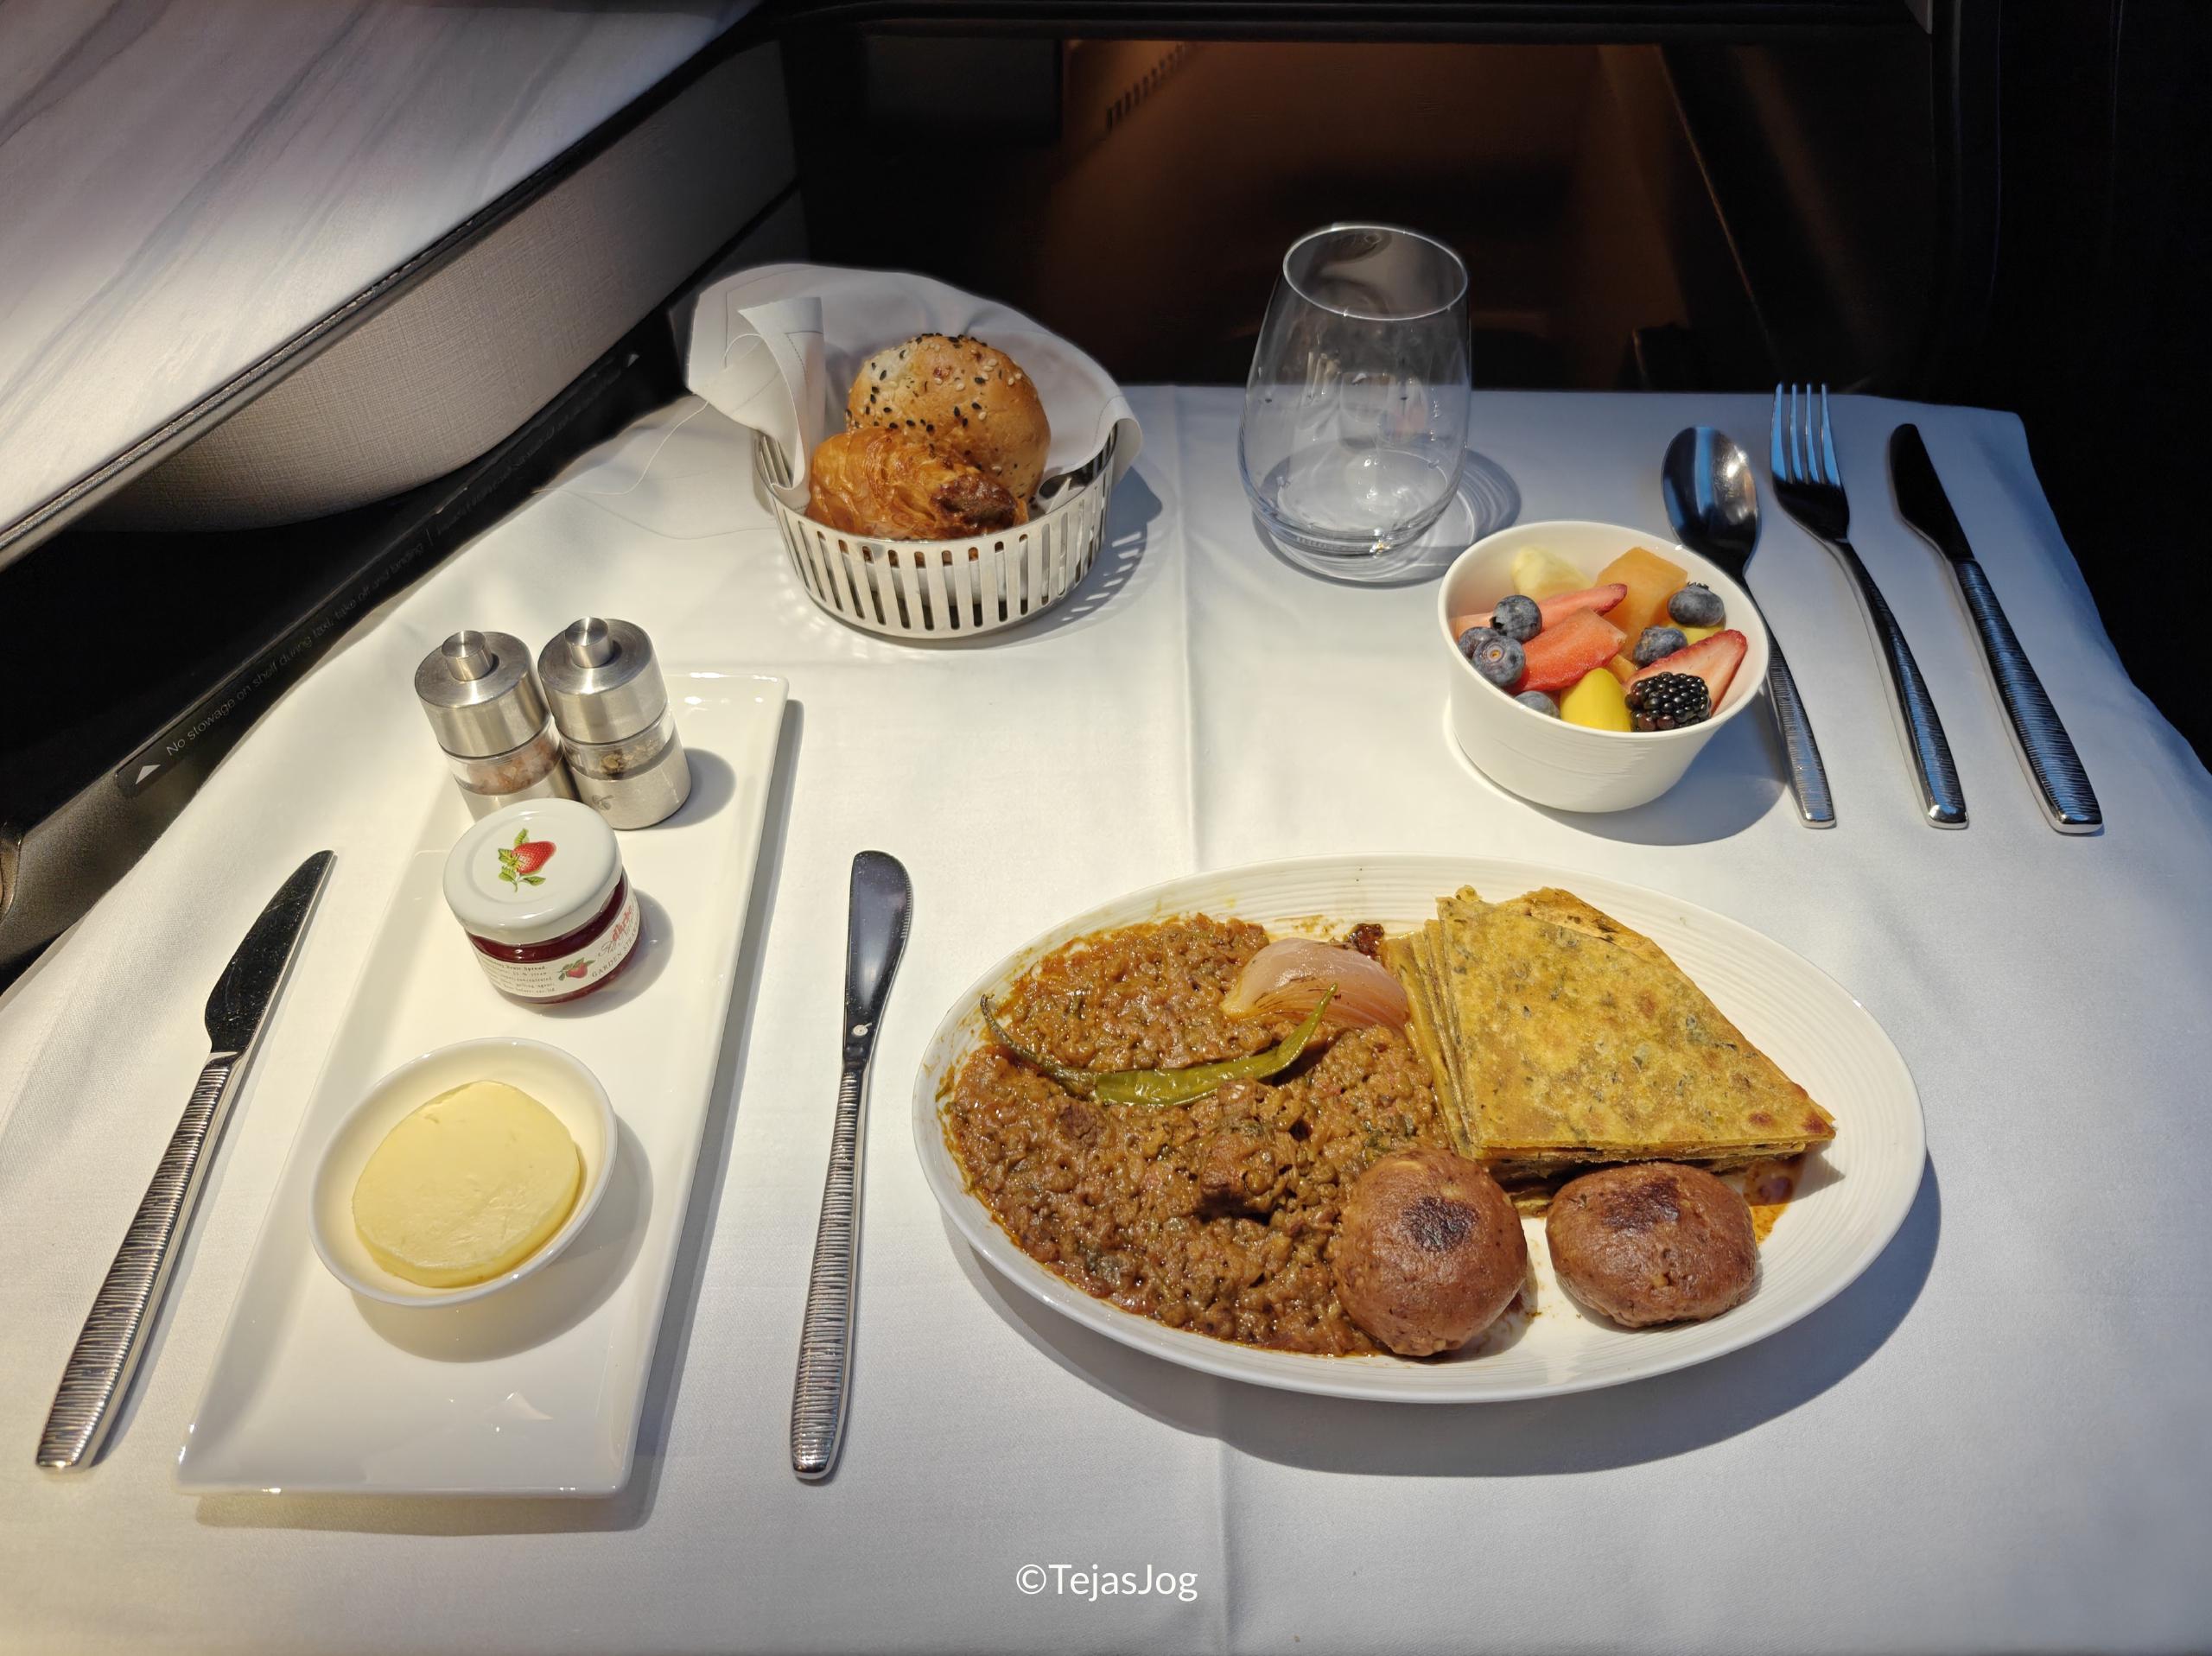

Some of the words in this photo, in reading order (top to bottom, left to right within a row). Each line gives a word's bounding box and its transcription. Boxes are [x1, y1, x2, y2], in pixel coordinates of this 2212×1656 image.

[166, 739, 185, 756] No
[187, 699, 235, 739] stowage
[236, 684, 252, 701] on
[592, 952, 622, 978] GARDEN
